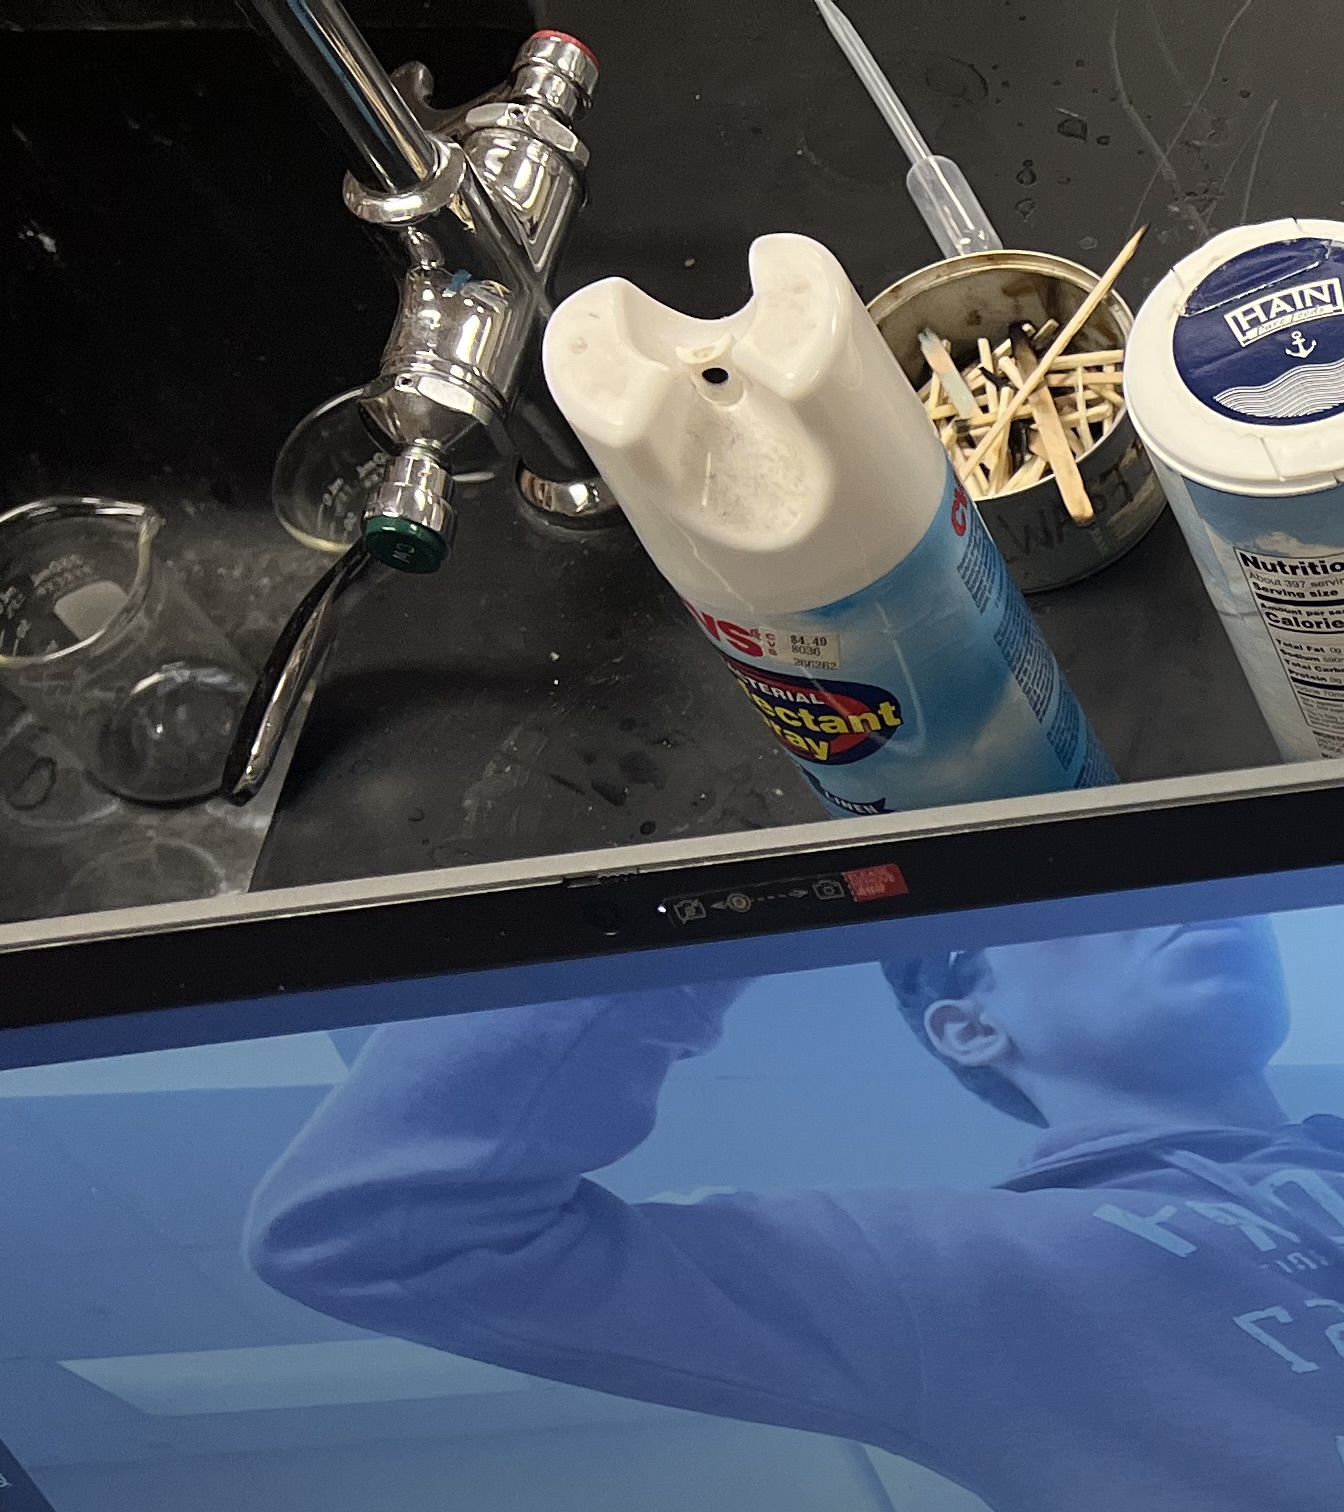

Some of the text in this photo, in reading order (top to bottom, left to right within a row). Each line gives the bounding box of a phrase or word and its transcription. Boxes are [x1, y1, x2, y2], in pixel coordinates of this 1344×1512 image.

[1240, 284, 1334, 331] HAIN
[1253, 581, 1305, 598] Serving
[1309, 589, 1338, 597] size
[1285, 580, 1306, 588] 397
[1260, 602, 1302, 615] Amount
[1275, 638, 1303, 651] Total
[1306, 645, 1325, 653] Fat
[1288, 668, 1327, 682] Protein
